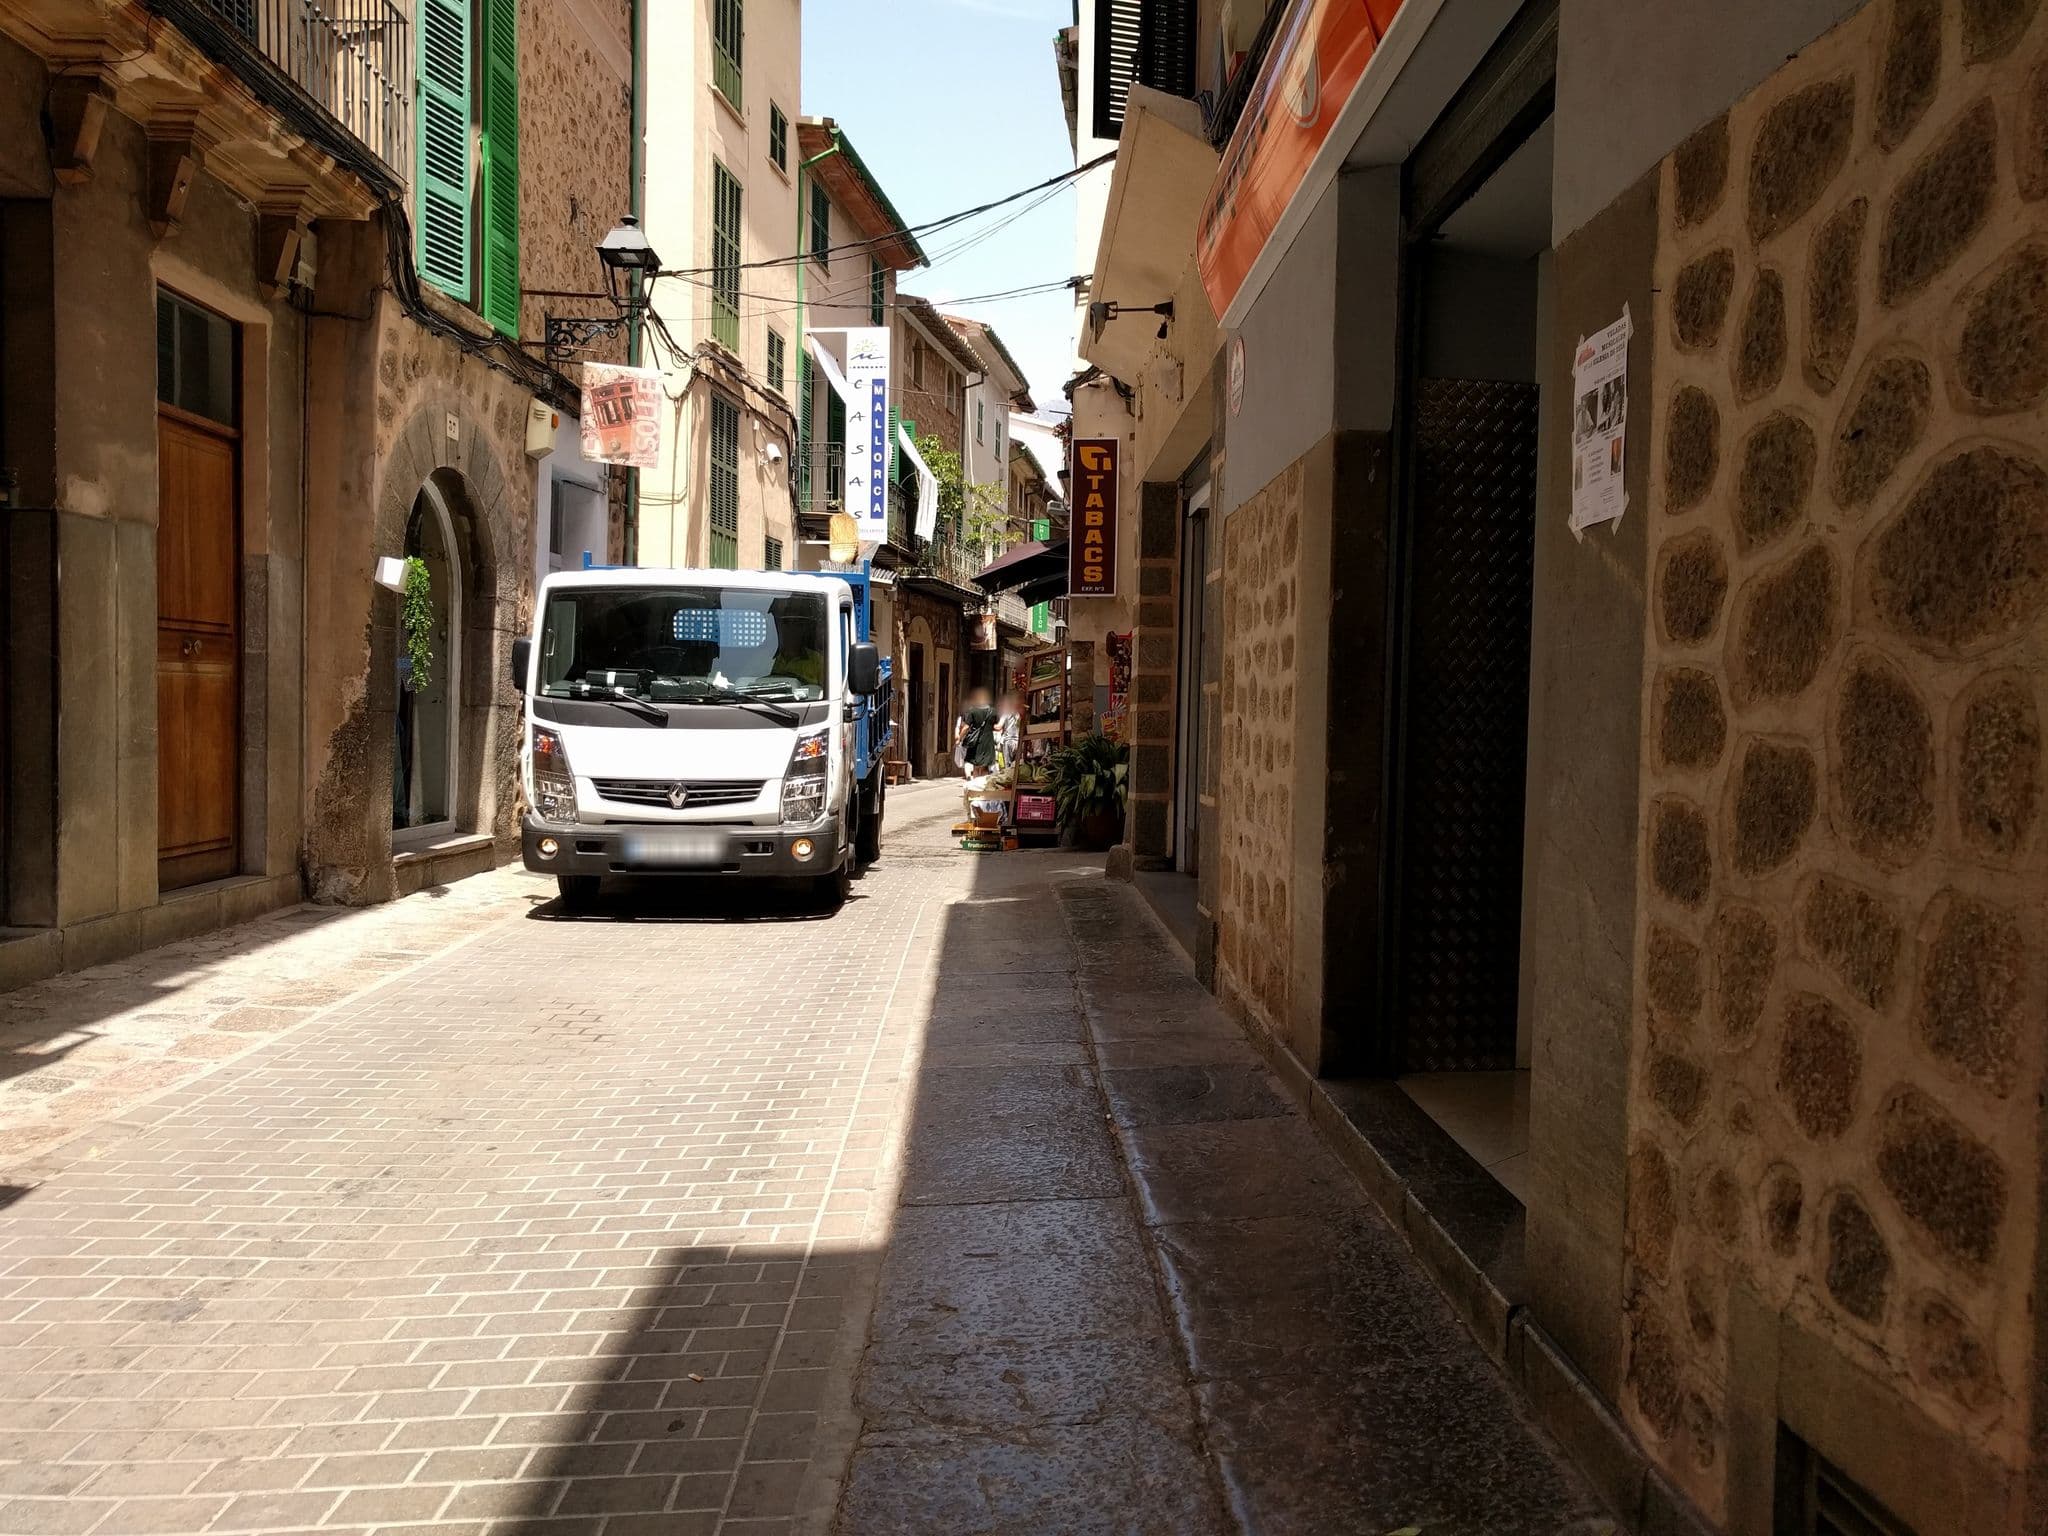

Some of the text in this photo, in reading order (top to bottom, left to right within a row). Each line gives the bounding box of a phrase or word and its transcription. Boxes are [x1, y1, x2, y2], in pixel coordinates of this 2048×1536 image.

[849, 379, 867, 519] CASAS
[873, 386, 884, 513] MALLORCA
[1083, 475, 1105, 582] TABACS
